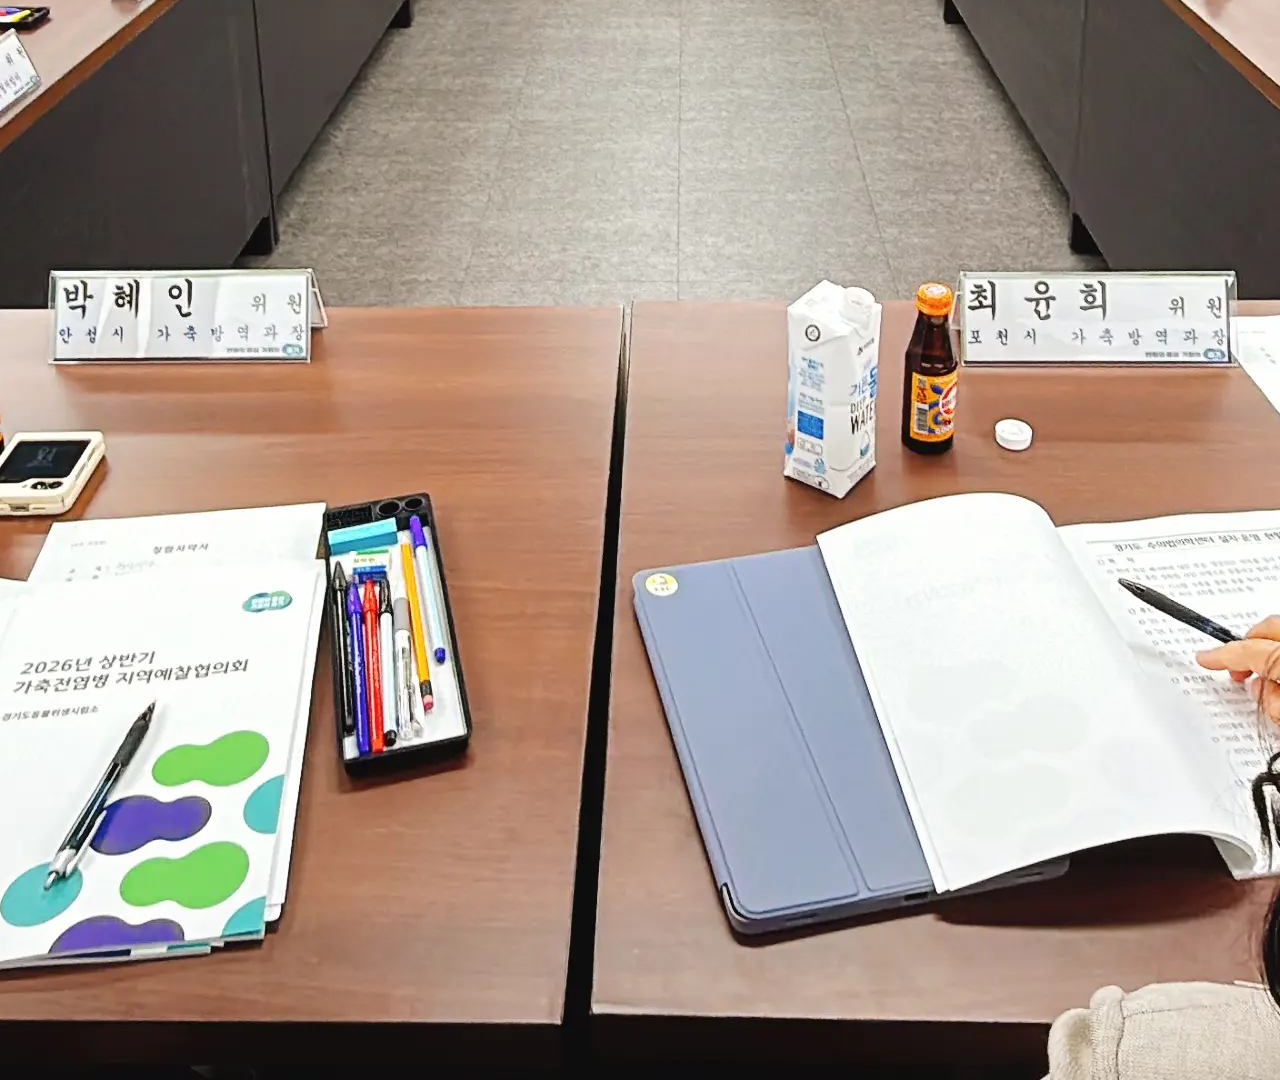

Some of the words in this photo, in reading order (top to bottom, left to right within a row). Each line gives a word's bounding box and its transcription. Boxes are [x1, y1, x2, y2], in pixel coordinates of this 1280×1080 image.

[63, 278, 195, 319] 박혜인
[251, 291, 304, 315] 위원
[967, 279, 1109, 321] 최윤희
[1168, 294, 1224, 320] 위원
[58, 325, 124, 344] 안성시
[157, 323, 305, 342] 가축방역과장
[967, 328, 1038, 346] 포천시
[1070, 326, 1227, 346] 가축방역과장
[850, 400, 876, 436] WATE
[12, 673, 110, 696] 가축전염병
[115, 658, 249, 686] 지역예찰협의회
[20, 657, 92, 676] 2026년
[99, 650, 156, 672] 상반기
[1, 704, 100, 723] 경기도동물위생시험소
